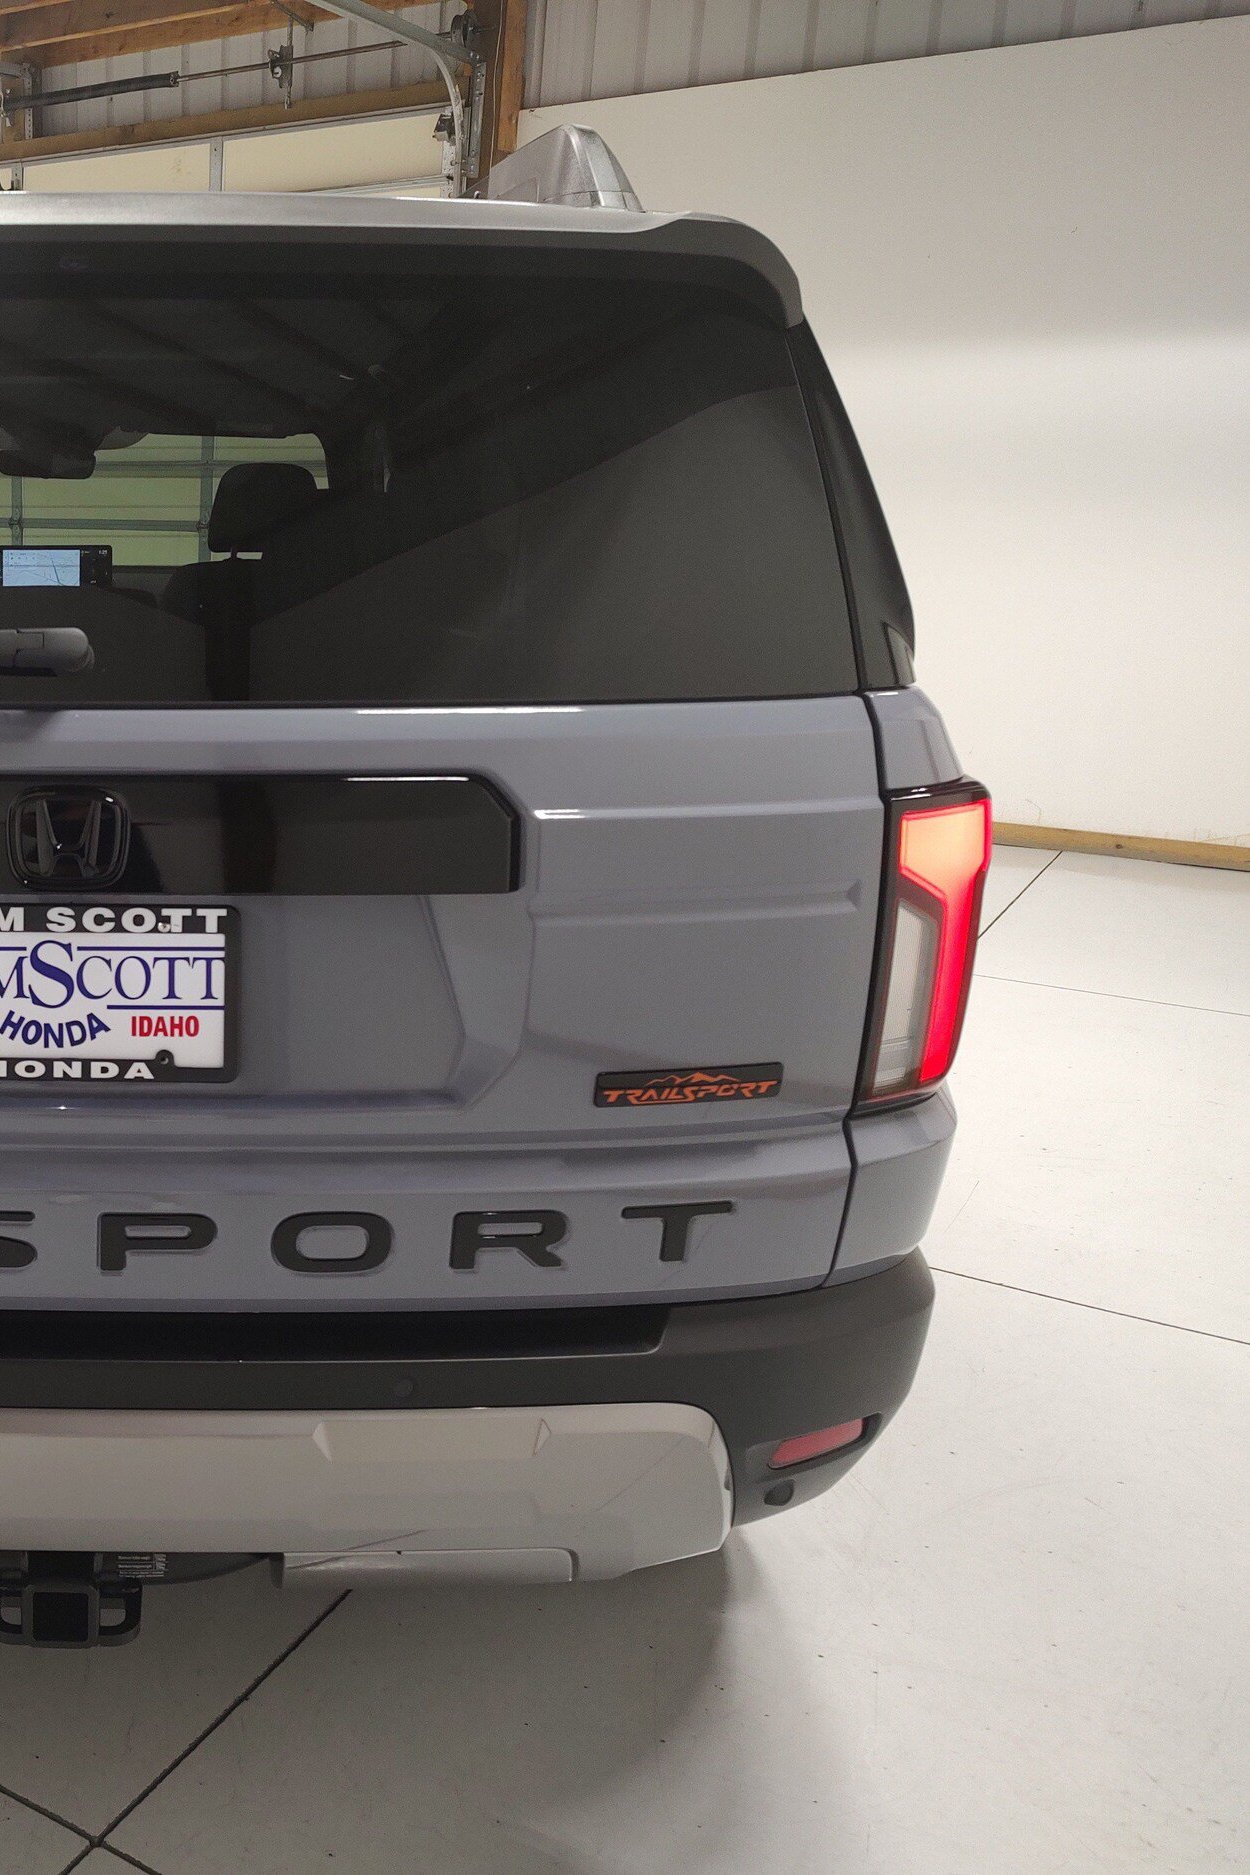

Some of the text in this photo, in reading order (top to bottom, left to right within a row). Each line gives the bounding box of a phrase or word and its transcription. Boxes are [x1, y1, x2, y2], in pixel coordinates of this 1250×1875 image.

[46, 906, 227, 933] SCOTT
[131, 1015, 199, 1037] IDAHO
[603, 1080, 778, 1105] TRAILSPORT
